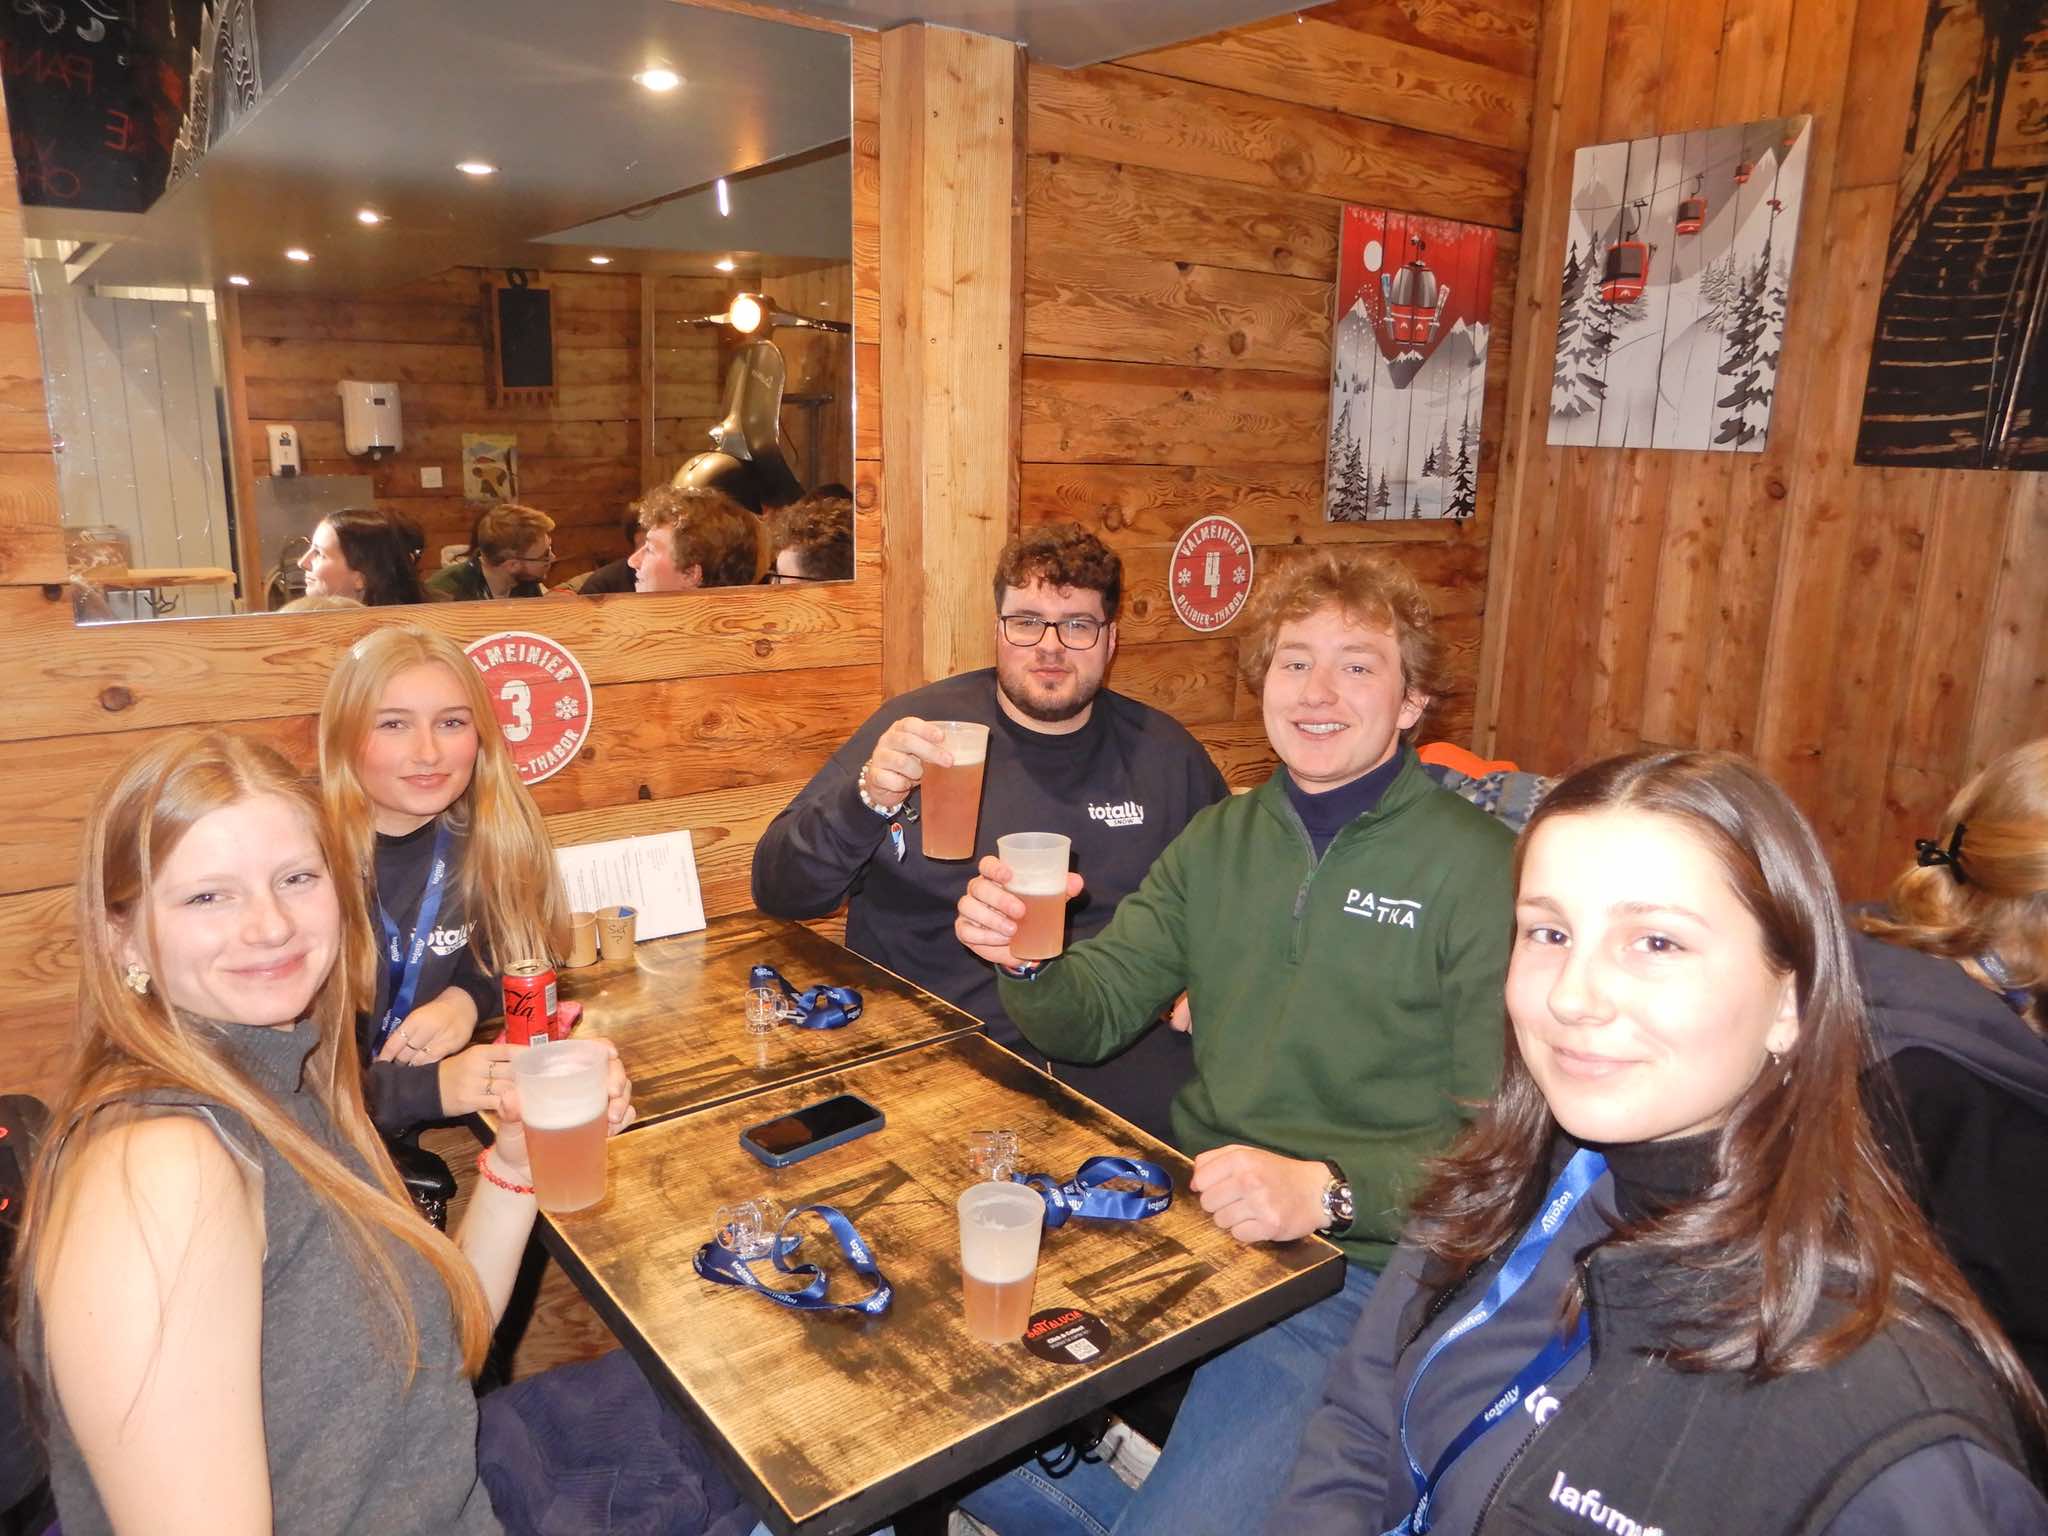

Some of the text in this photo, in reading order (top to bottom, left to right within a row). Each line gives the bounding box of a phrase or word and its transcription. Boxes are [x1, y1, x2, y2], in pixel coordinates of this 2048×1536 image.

[1180, 525, 1247, 556] VALMEINIER
[1204, 551, 1221, 598] 4
[472, 643, 574, 682] LMEINIER
[500, 680, 532, 742] 3
[515, 728, 580, 774] -THABOR
[1088, 801, 1144, 820] totally
[1541, 1191, 1573, 1232] totally
[1484, 1385, 1520, 1422] totally
